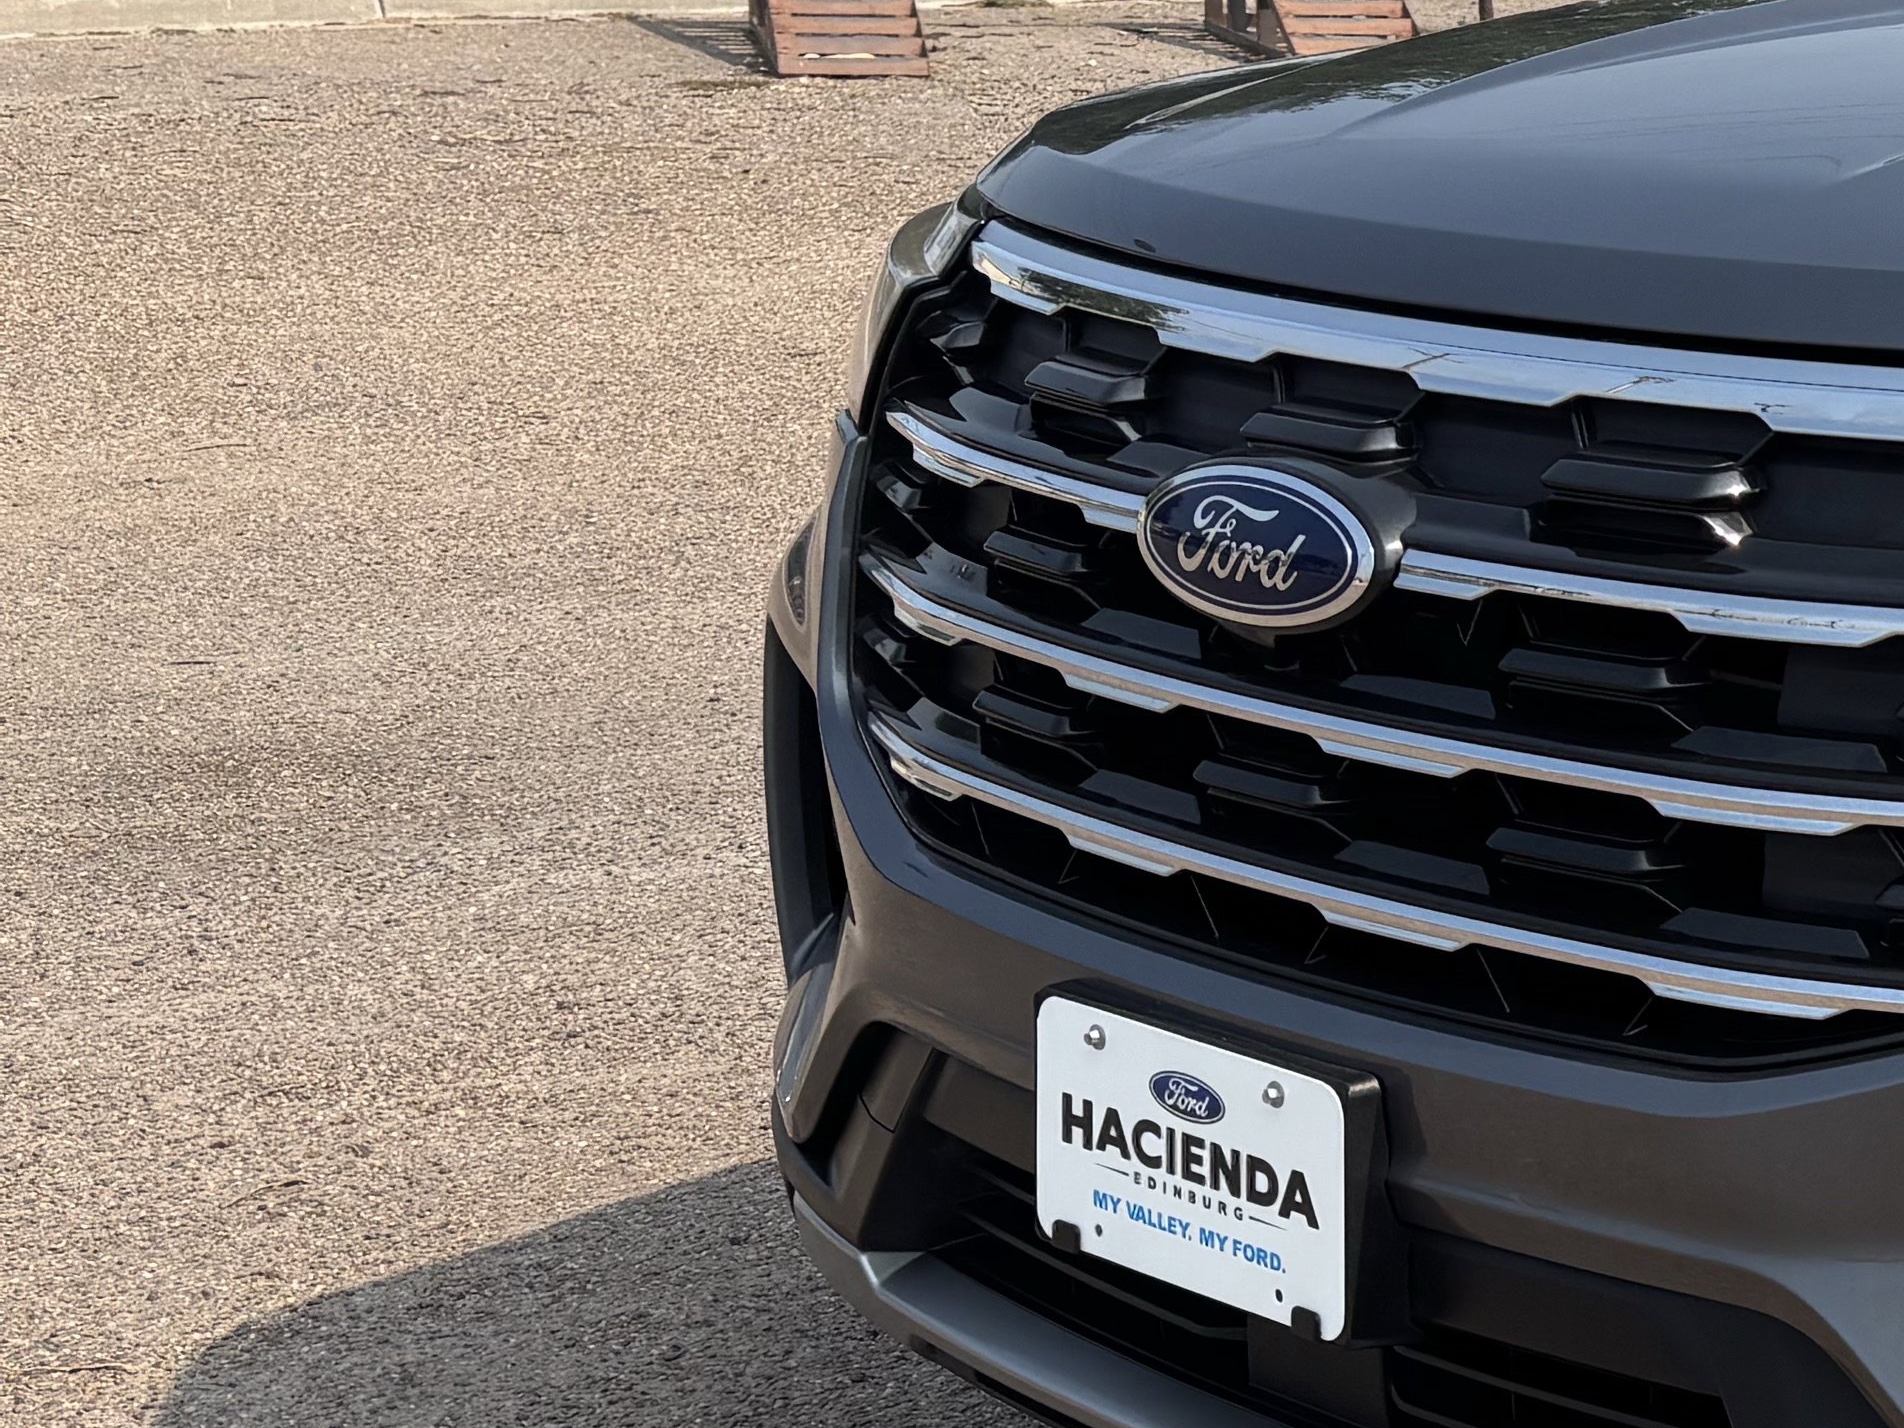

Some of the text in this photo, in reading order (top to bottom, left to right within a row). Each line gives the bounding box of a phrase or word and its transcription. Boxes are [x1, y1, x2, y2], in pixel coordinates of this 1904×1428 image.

[1177, 495, 1306, 591] Ford
[1164, 1077, 1209, 1117] Ford
[1062, 1091, 1320, 1231] HACIENDA
[1133, 1171, 1244, 1221] EDINBURG
[1093, 1189, 1287, 1274] MY VALLEY. MY FORD.
